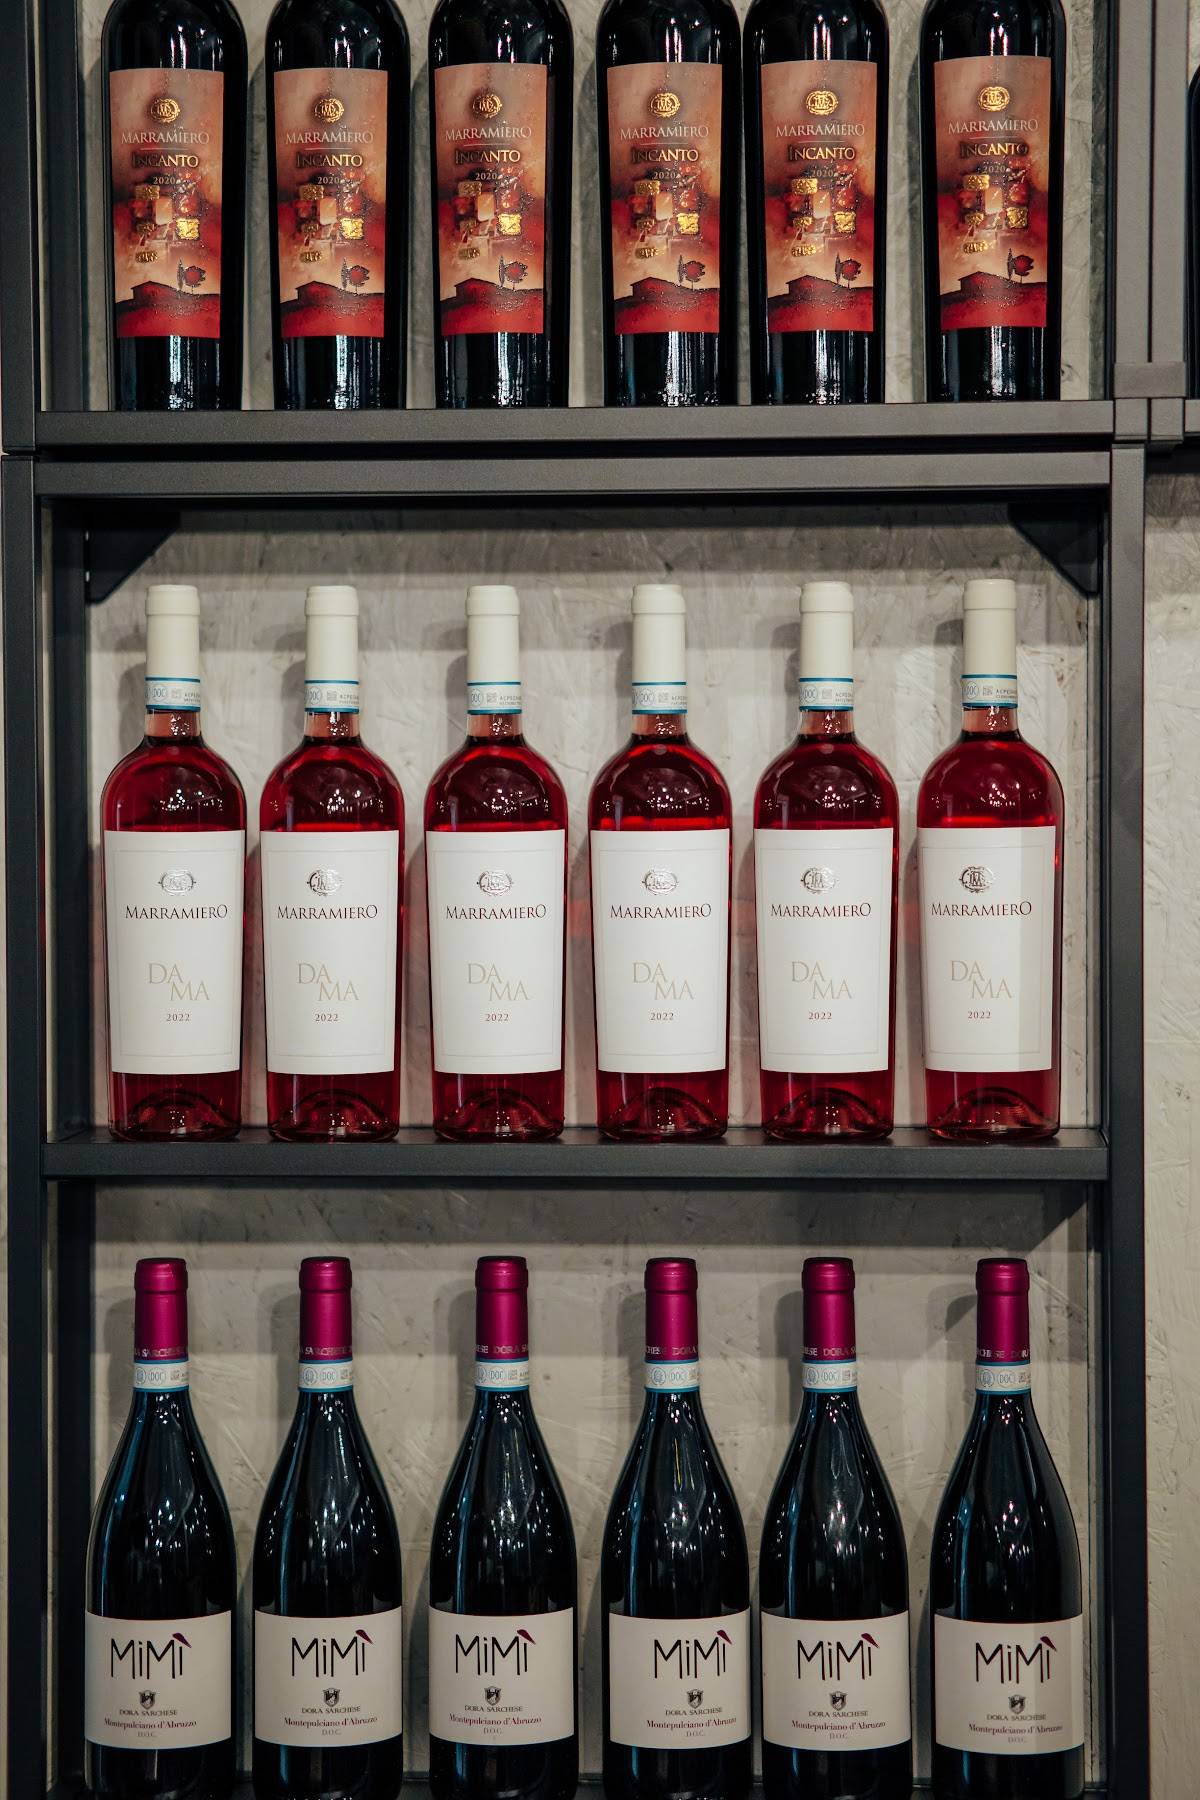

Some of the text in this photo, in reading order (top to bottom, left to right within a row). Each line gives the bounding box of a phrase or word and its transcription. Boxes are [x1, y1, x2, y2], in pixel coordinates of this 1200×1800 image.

[776, 124, 864, 138] MARRAMIERO
[948, 118, 1038, 134] MARRAMIERO
[121, 131, 209, 145] MARRAMIERO
[286, 130, 373, 145] MARRAMIERO
[445, 126, 531, 140] MARRAMIERO
[620, 125, 709, 140] MARRAMIERO
[632, 147, 698, 163] INCANTO
[788, 146, 855, 161] INCANTO
[960, 141, 1028, 157] INCANTO
[132, 153, 198, 168] INCANTO
[296, 152, 362, 168] INCANTO
[455, 148, 521, 164] INCANTO
[811, 169, 833, 178] 2020
[982, 165, 1006, 174] 2020
[153, 177, 177, 185] 2020
[317, 177, 340, 185] 2020
[475, 172, 498, 180] 2020
[653, 172, 676, 180] 2020
[125, 904, 228, 920] MARRAMIERO
[277, 904, 378, 920] MARRAMIERO
[446, 904, 546, 920] MARRAMIERO
[610, 903, 712, 919] MARRAMIERO
[771, 903, 871, 918] MARRAMIERO
[931, 902, 1032, 917] MARRAMIERO
[166, 1013, 190, 1022] 2022
[315, 1013, 339, 1022] 2022
[485, 1013, 509, 1022] 2022
[650, 1012, 674, 1021] 2022
[808, 1012, 832, 1020] 2022
[968, 1011, 992, 1019] 2022
[141, 1709, 177, 1717] SARCHESE
[486, 1705, 522, 1713] SARCHESE
[689, 1707, 723, 1715] SARCHESE
[104, 1718, 197, 1730] Montepulciano d'Abruzzo
[284, 1716, 377, 1726] Montepulciano d'Abruzzo
[449, 1713, 542, 1725] Montepulciano d'Abruzzo
[646, 1716, 737, 1730] Montepulciano d'Abruzzo
[792, 1720, 886, 1730] Montepulciano d'Abruzzo
[968, 1724, 1063, 1734] Montepulciano d'Abruzzo
